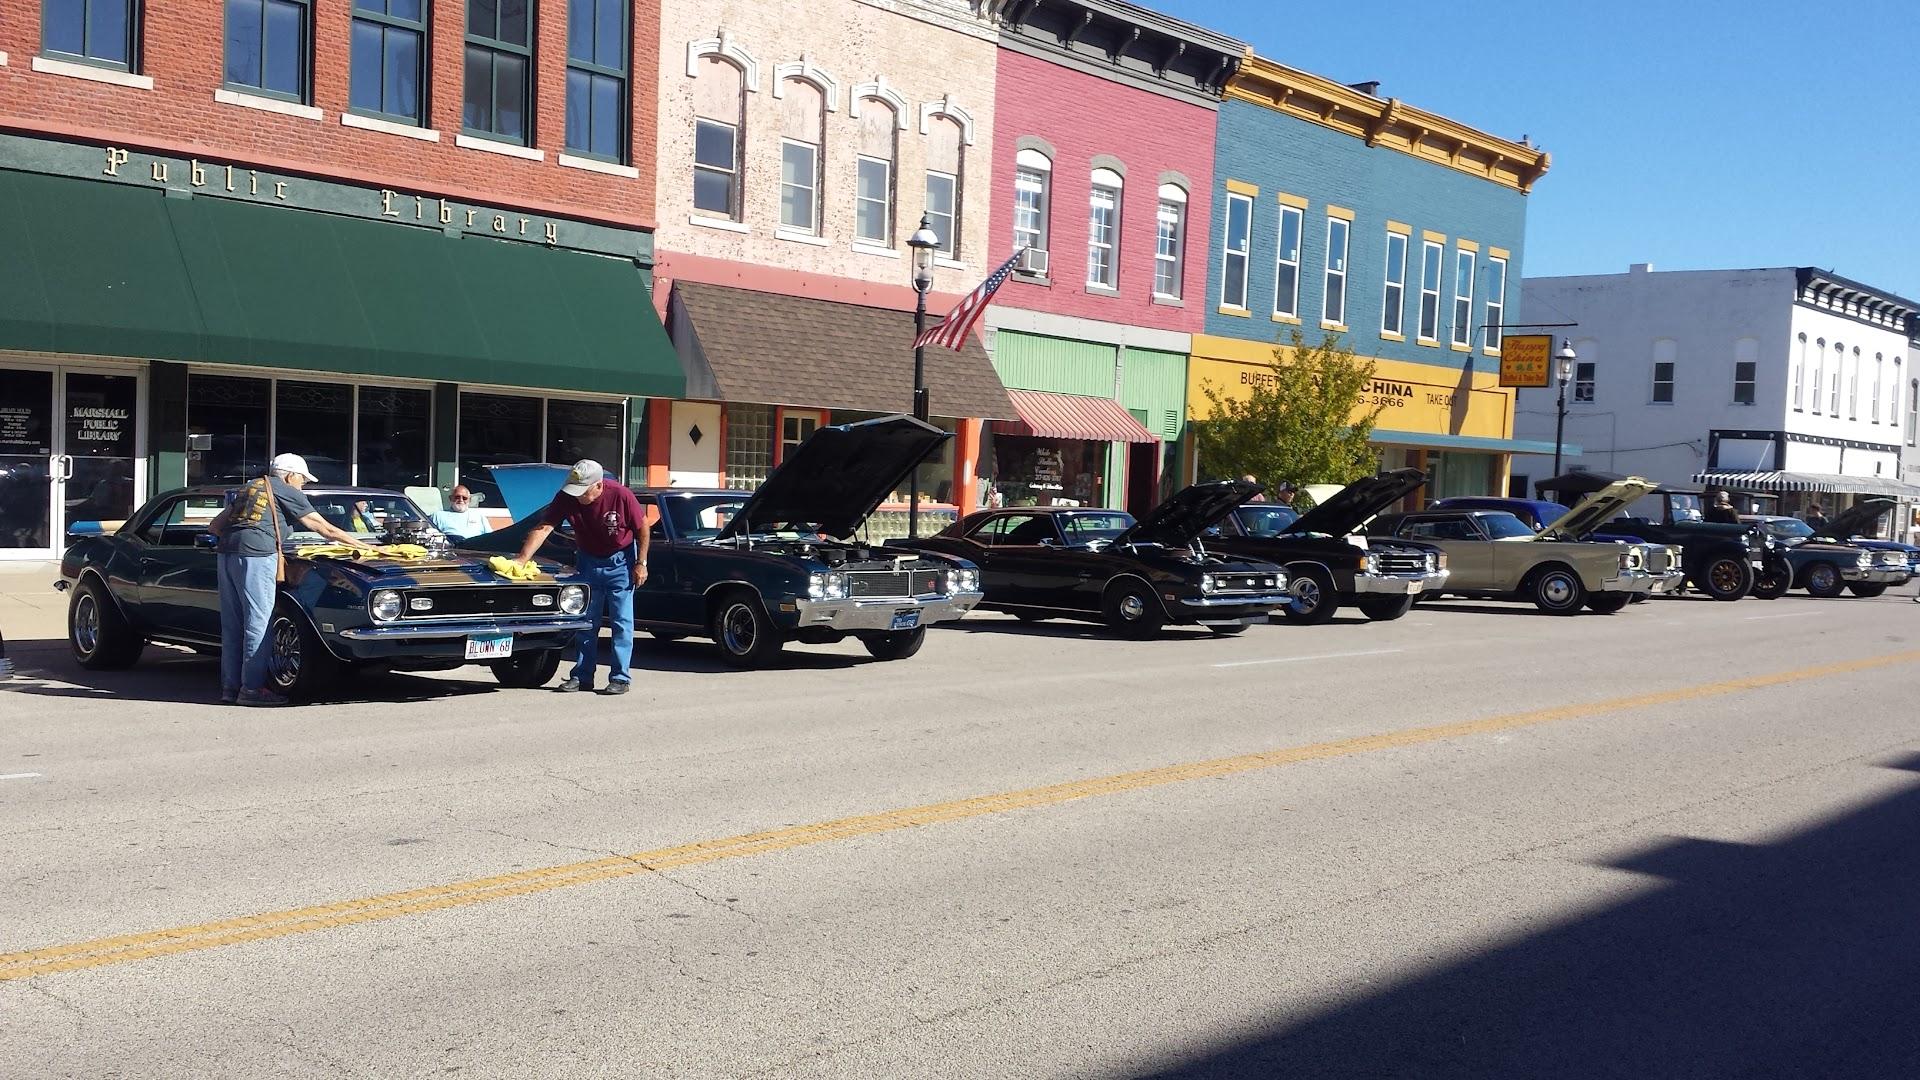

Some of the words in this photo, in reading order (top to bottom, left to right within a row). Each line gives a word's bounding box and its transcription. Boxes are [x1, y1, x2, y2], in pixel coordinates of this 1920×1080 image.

[103, 147, 288, 200] Public
[380, 189, 558, 244] Library
[1240, 371, 1280, 388] BUFFET
[1360, 381, 1414, 398] CHINA
[1357, 394, 1404, 408] 6-3666
[1426, 393, 1443, 406] TAKE
[73, 407, 129, 419] MARSHALL
[83, 419, 119, 430] PUBLIC
[78, 430, 122, 441] LIBRARY
